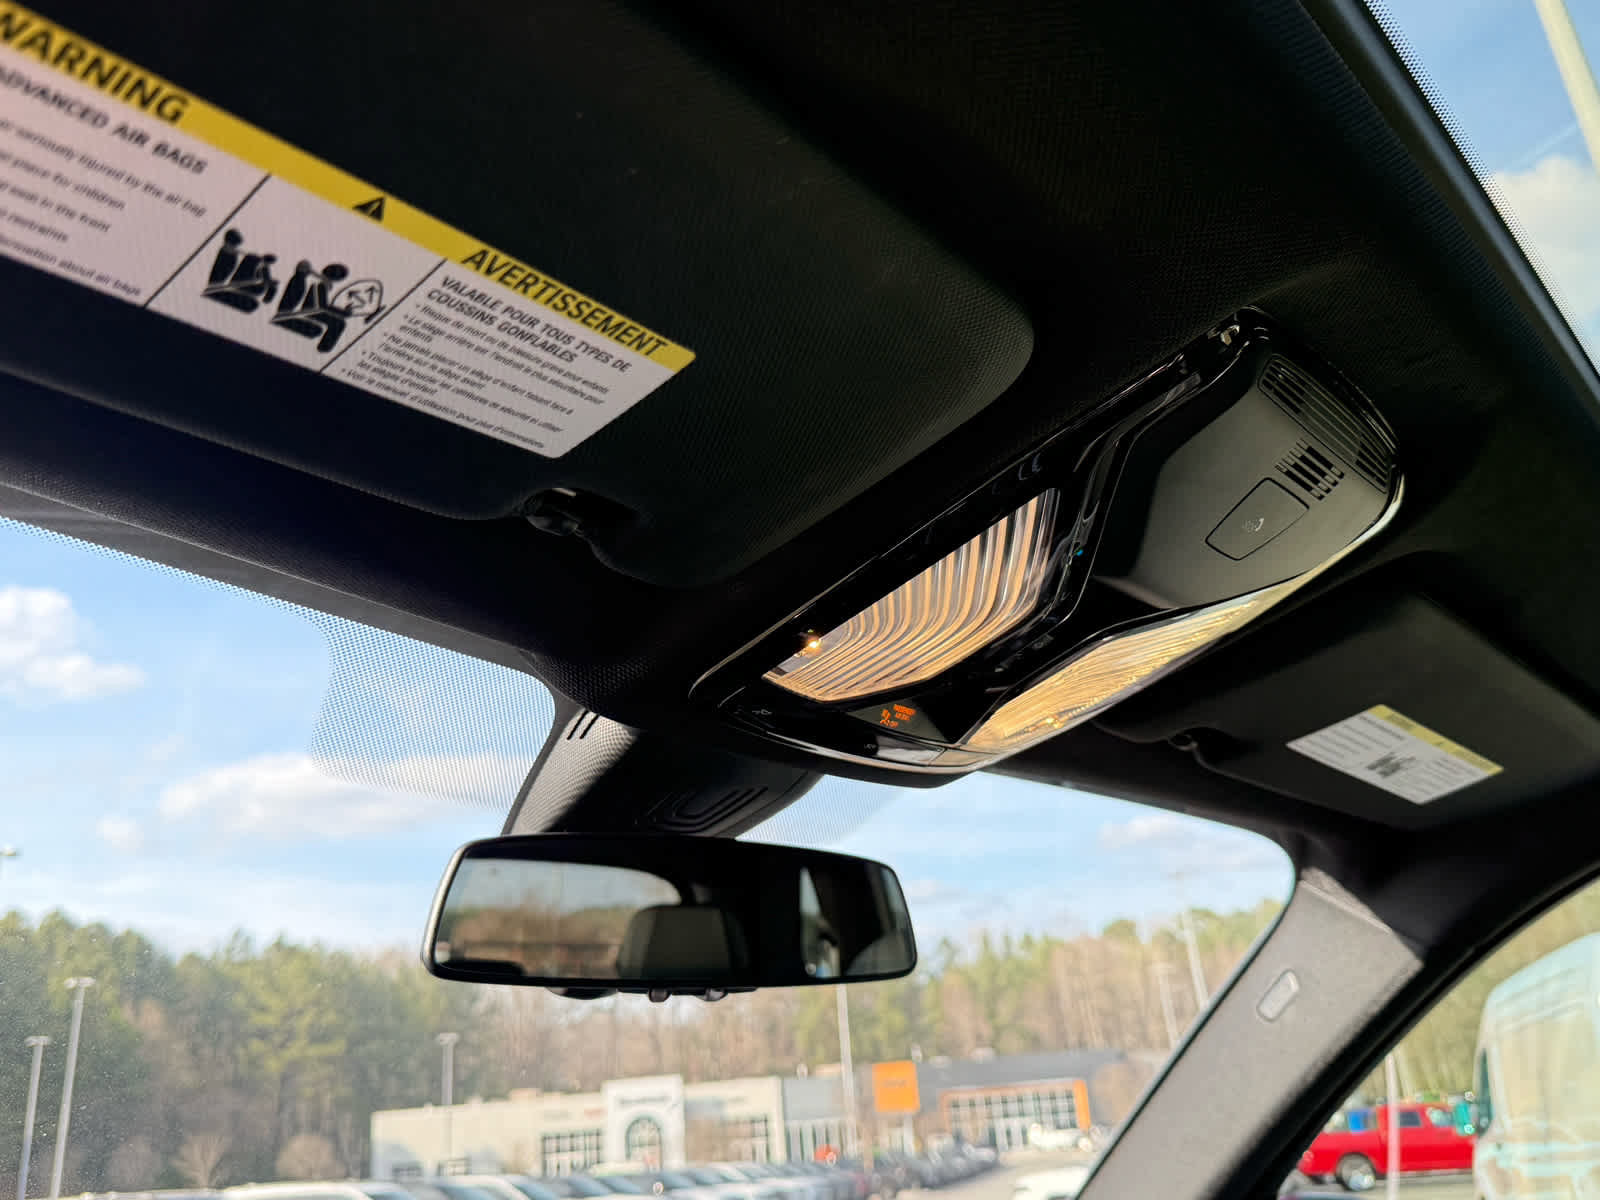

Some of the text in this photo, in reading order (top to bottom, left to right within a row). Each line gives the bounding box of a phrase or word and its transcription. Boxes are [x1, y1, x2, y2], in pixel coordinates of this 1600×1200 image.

[0, 68, 111, 129] ADVANCED
[111, 122, 151, 147] AIR
[151, 140, 209, 173] BAGS
[426, 287, 578, 363] COUSSINS GONFLABLES
[439, 275, 631, 373] VALABLE POUR TOUS TYPES DE
[462, 248, 667, 357] AVERTISSEMENT
